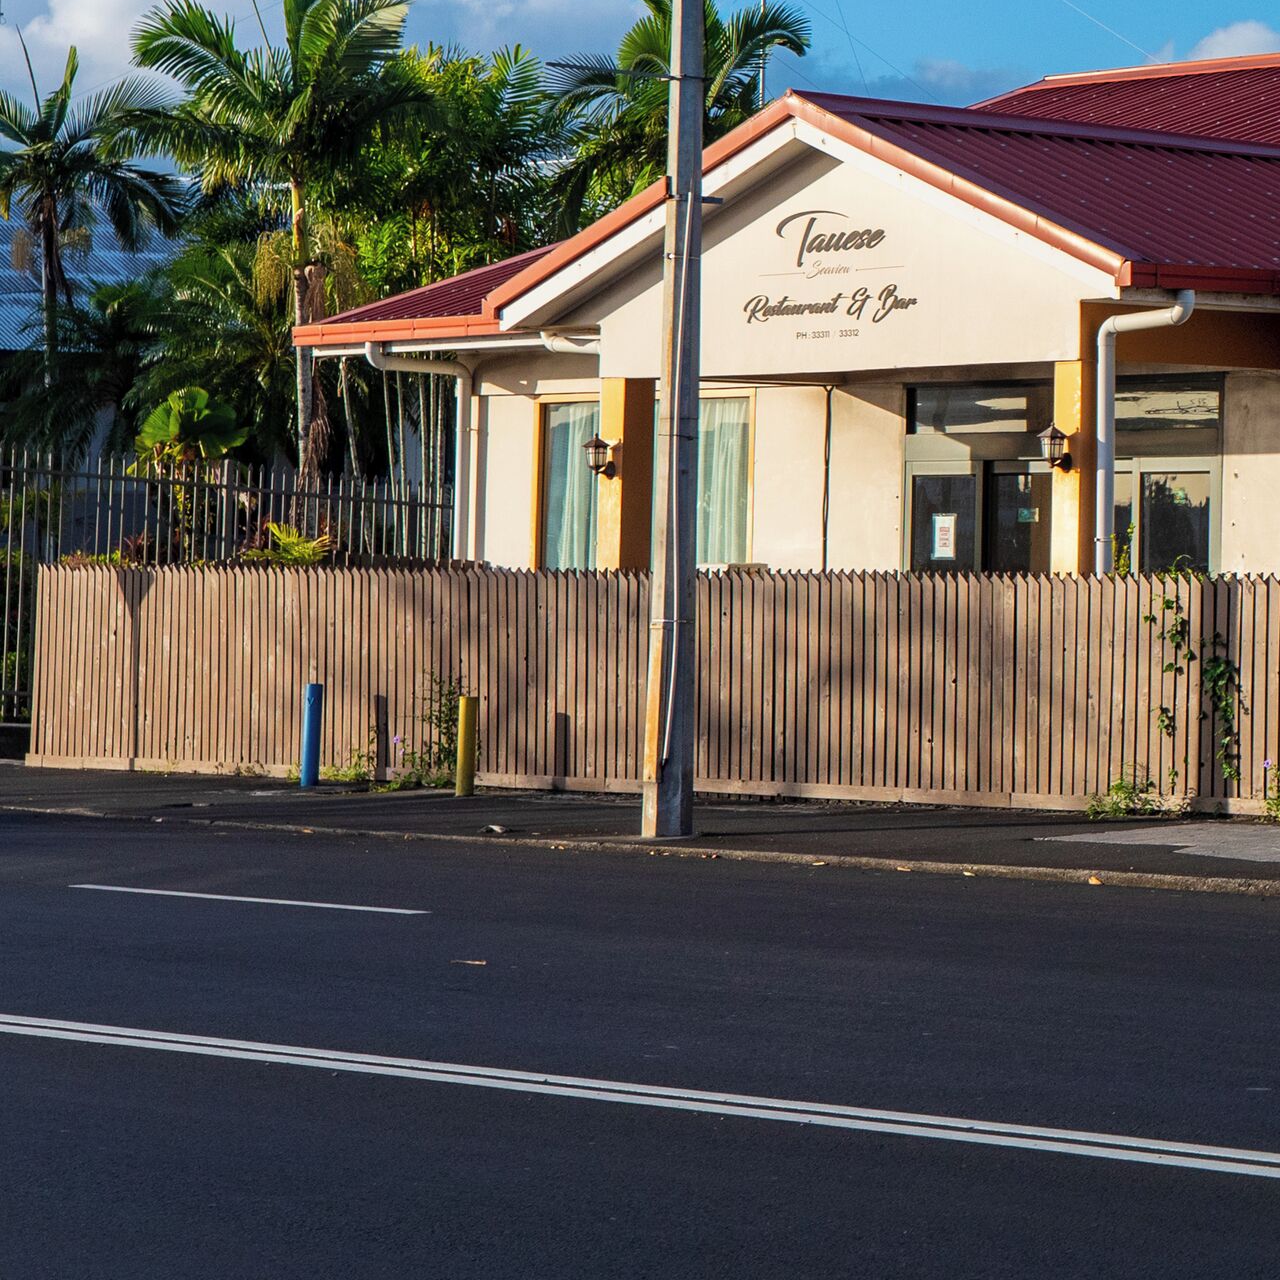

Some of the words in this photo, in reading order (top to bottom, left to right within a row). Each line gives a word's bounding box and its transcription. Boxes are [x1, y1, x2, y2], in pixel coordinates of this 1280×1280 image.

[776, 210, 887, 267] Tauese
[806, 260, 850, 279] Seaview
[744, 293, 848, 324] Restaurant
[846, 287, 874, 320] &
[872, 284, 918, 324] Bar
[839, 328, 860, 338] 33312
